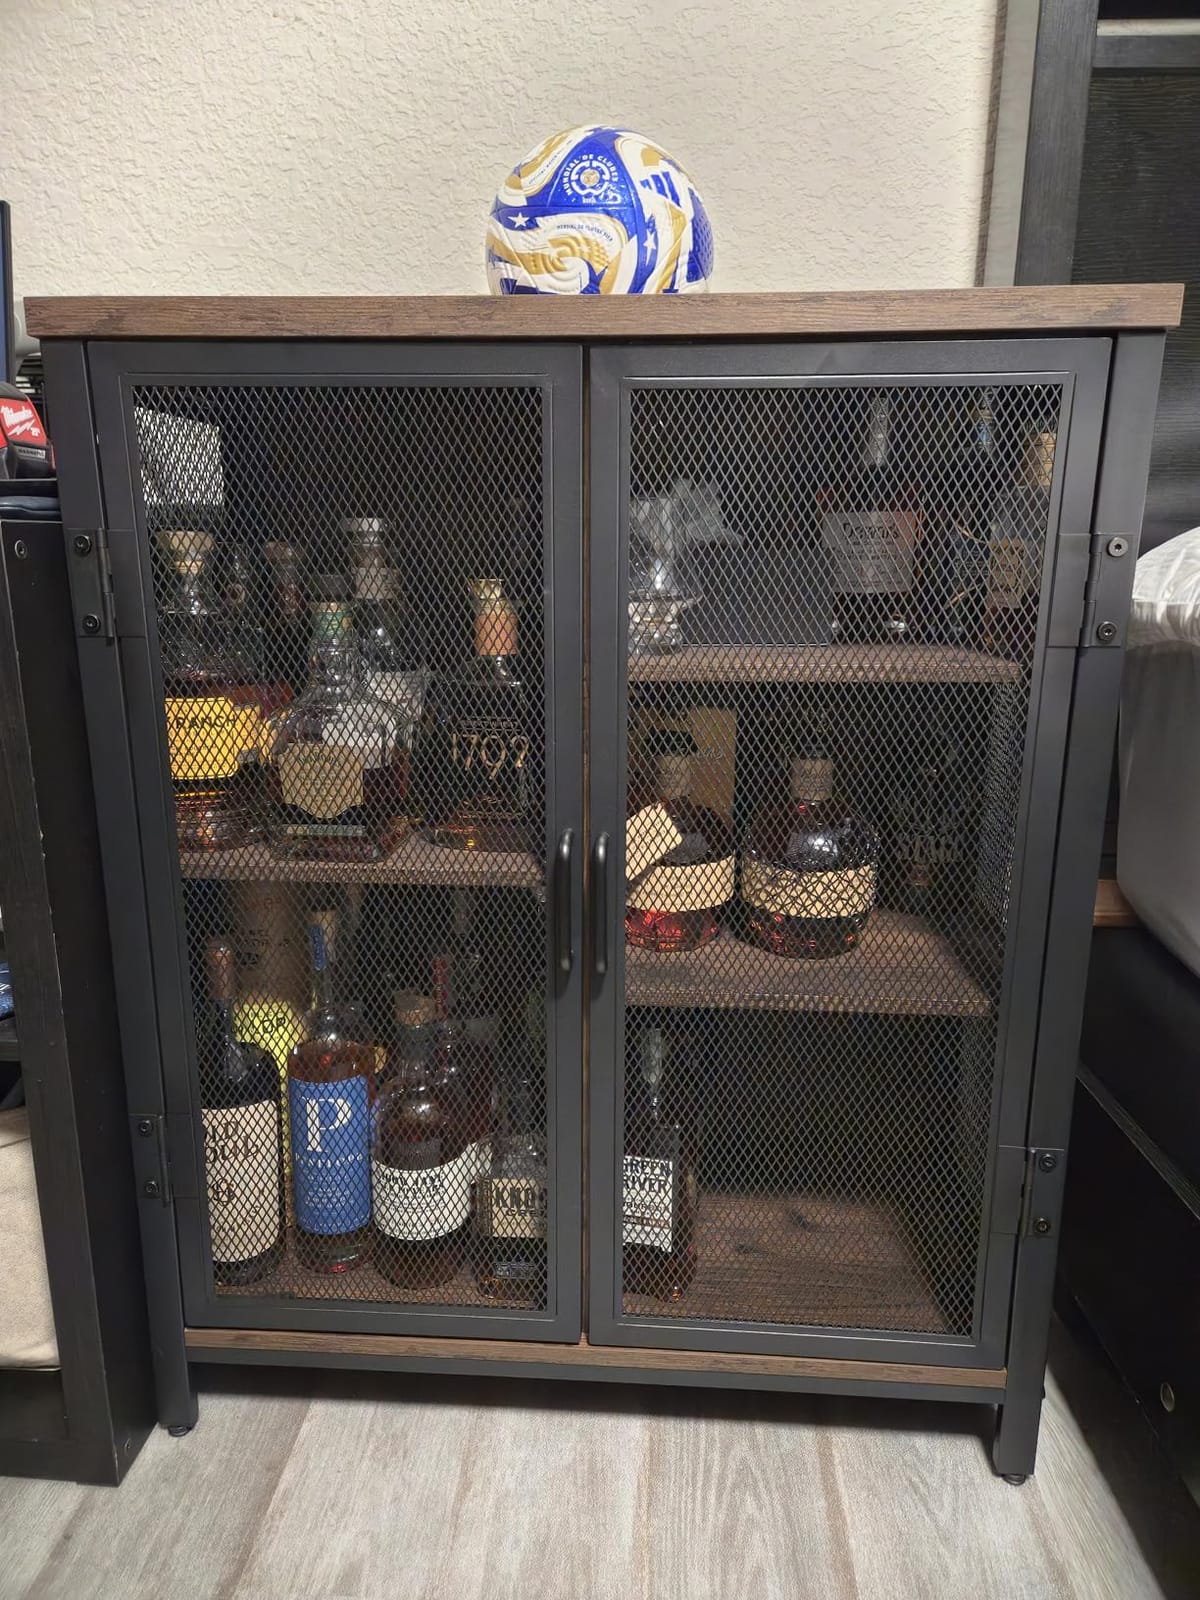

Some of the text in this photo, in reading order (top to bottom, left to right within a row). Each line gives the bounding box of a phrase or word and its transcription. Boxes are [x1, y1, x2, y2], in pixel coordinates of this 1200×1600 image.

[563, 159, 581, 196] MUNDIAL
[581, 154, 594, 162] DE
[597, 156, 619, 182] CLUBES
[301, 1096, 352, 1152] P
